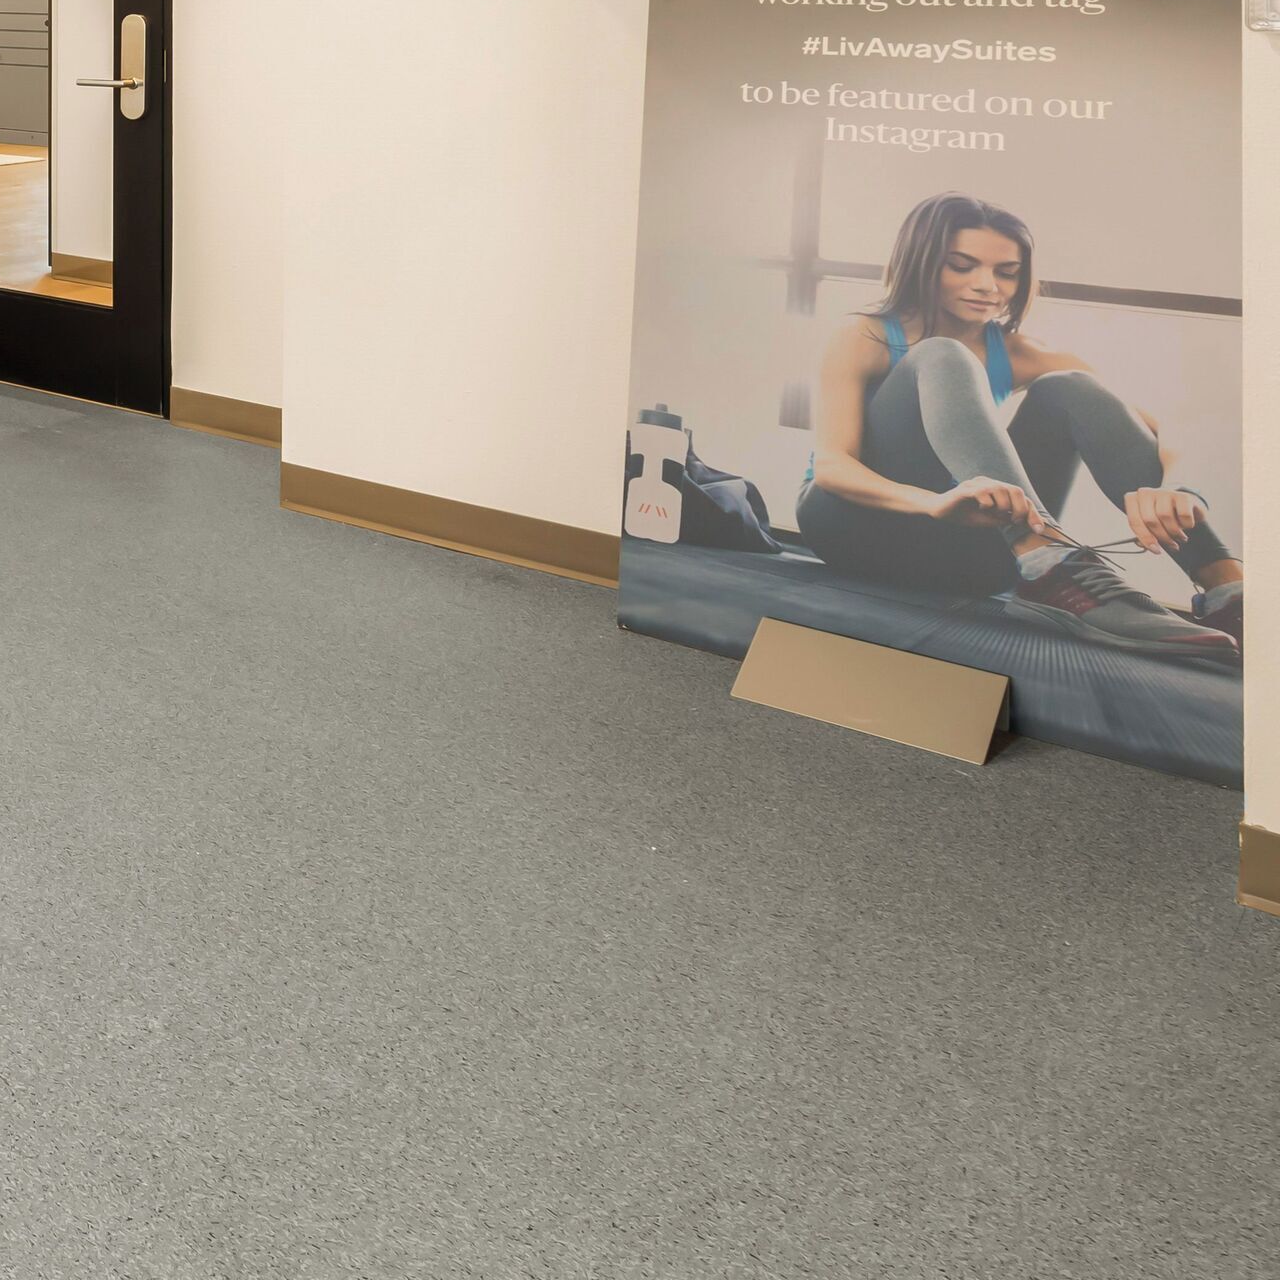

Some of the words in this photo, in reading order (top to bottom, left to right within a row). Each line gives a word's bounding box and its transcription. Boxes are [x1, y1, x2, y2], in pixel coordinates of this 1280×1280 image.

[802, 36, 1056, 64] #LivAwaySuites
[741, 81, 773, 104] to
[780, 81, 820, 106] be
[826, 82, 976, 115] featured
[985, 93, 1033, 117] on
[1043, 96, 1112, 120] our
[825, 117, 1006, 154] Instagram
